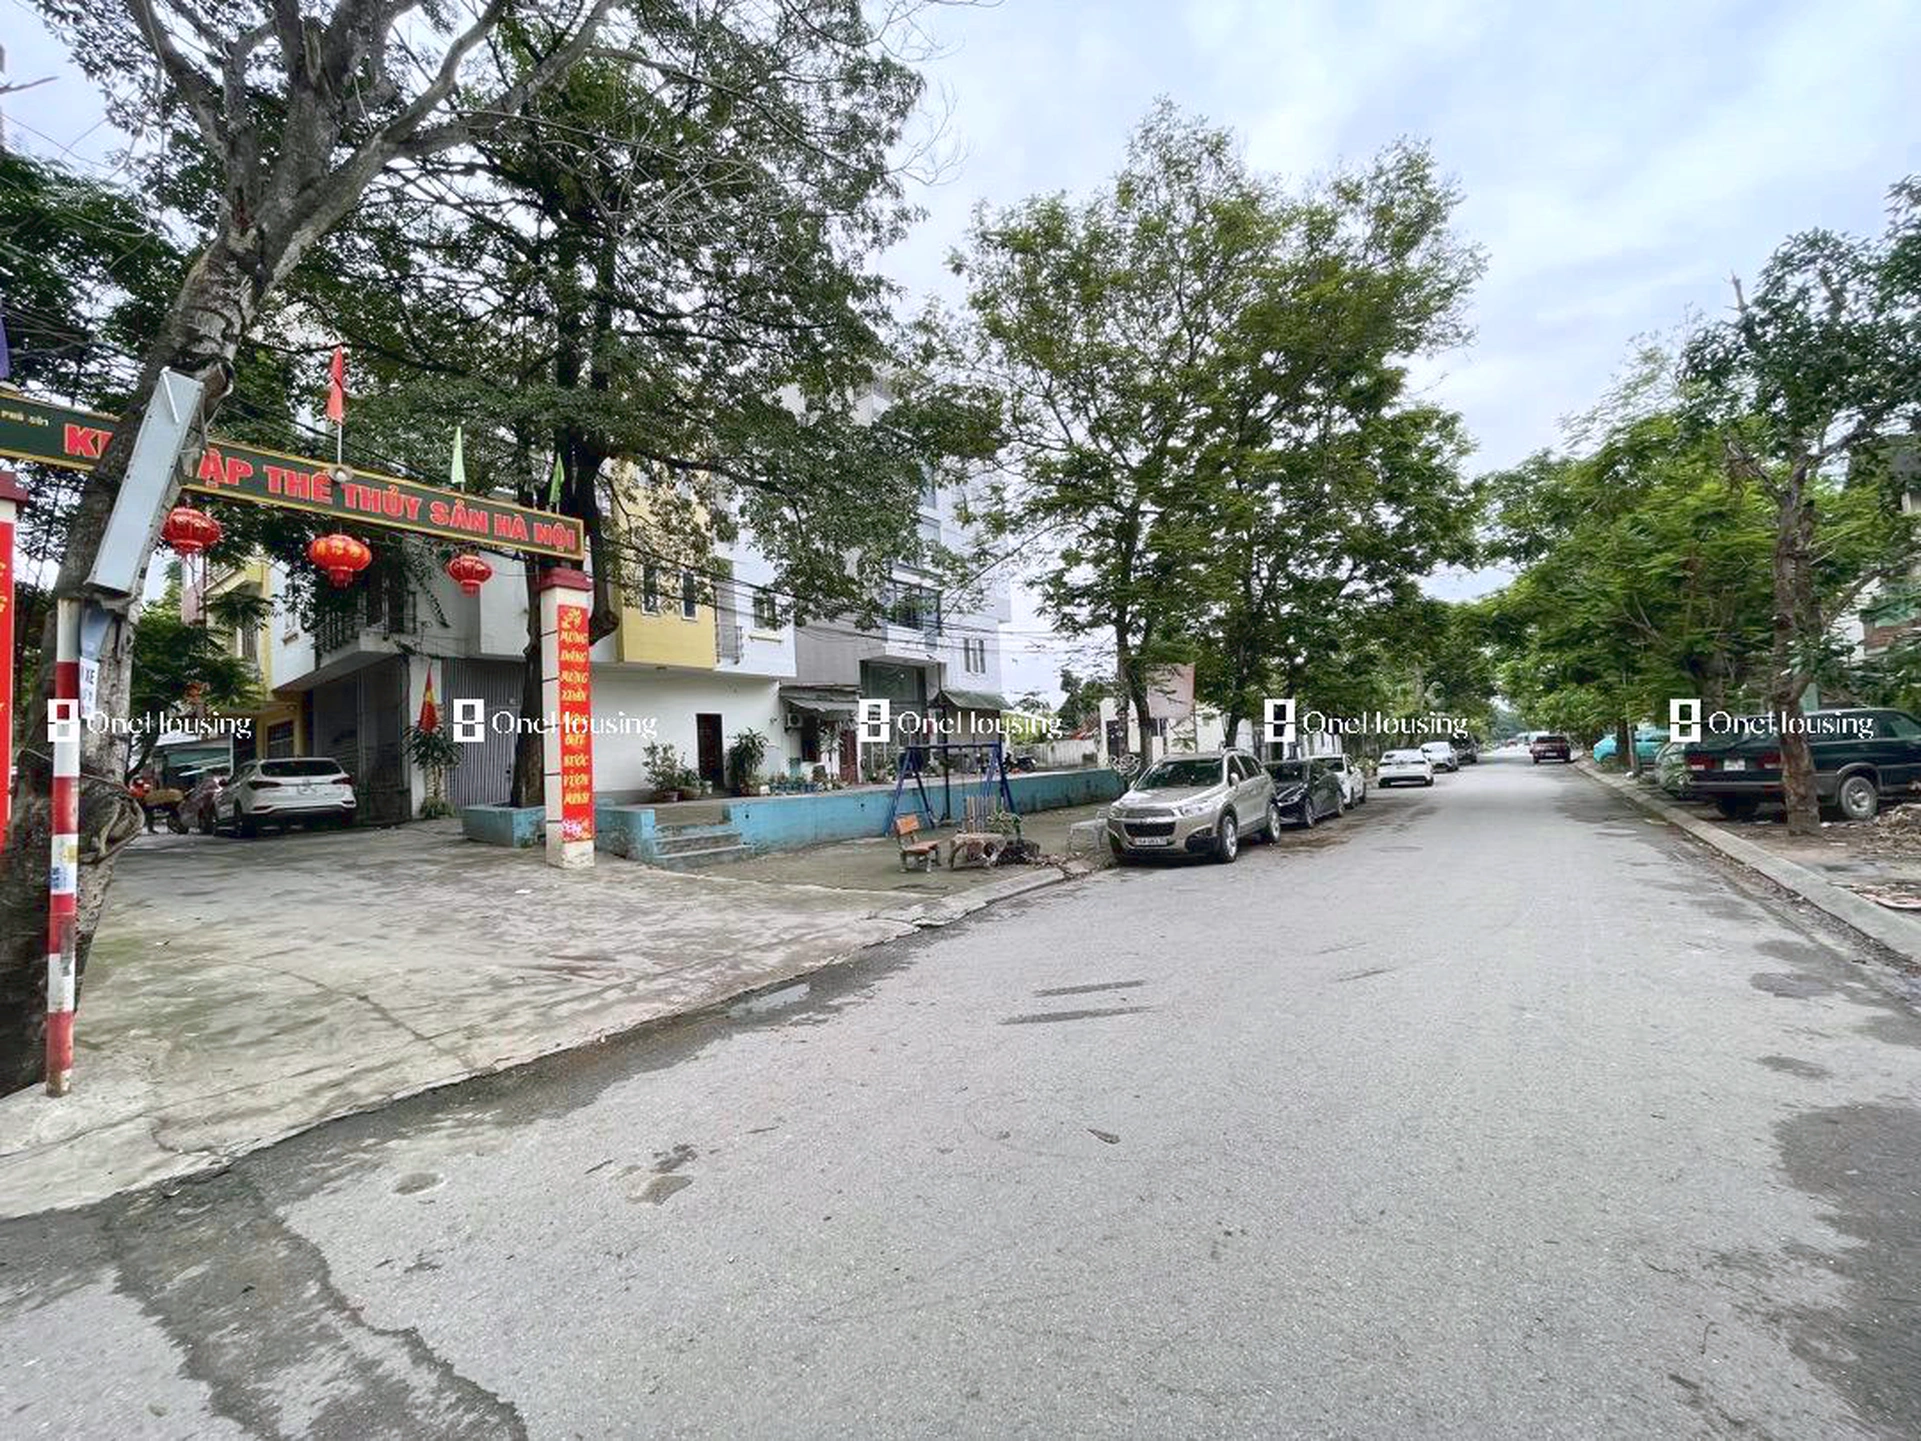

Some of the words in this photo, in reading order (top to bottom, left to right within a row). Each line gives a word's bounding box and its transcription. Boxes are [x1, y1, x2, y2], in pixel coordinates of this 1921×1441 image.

[197, 448, 254, 489] ẬP
[341, 484, 423, 520] THỦY
[429, 499, 489, 534] SẢN
[493, 513, 529, 541] HÀ
[533, 522, 576, 552] NỘI
